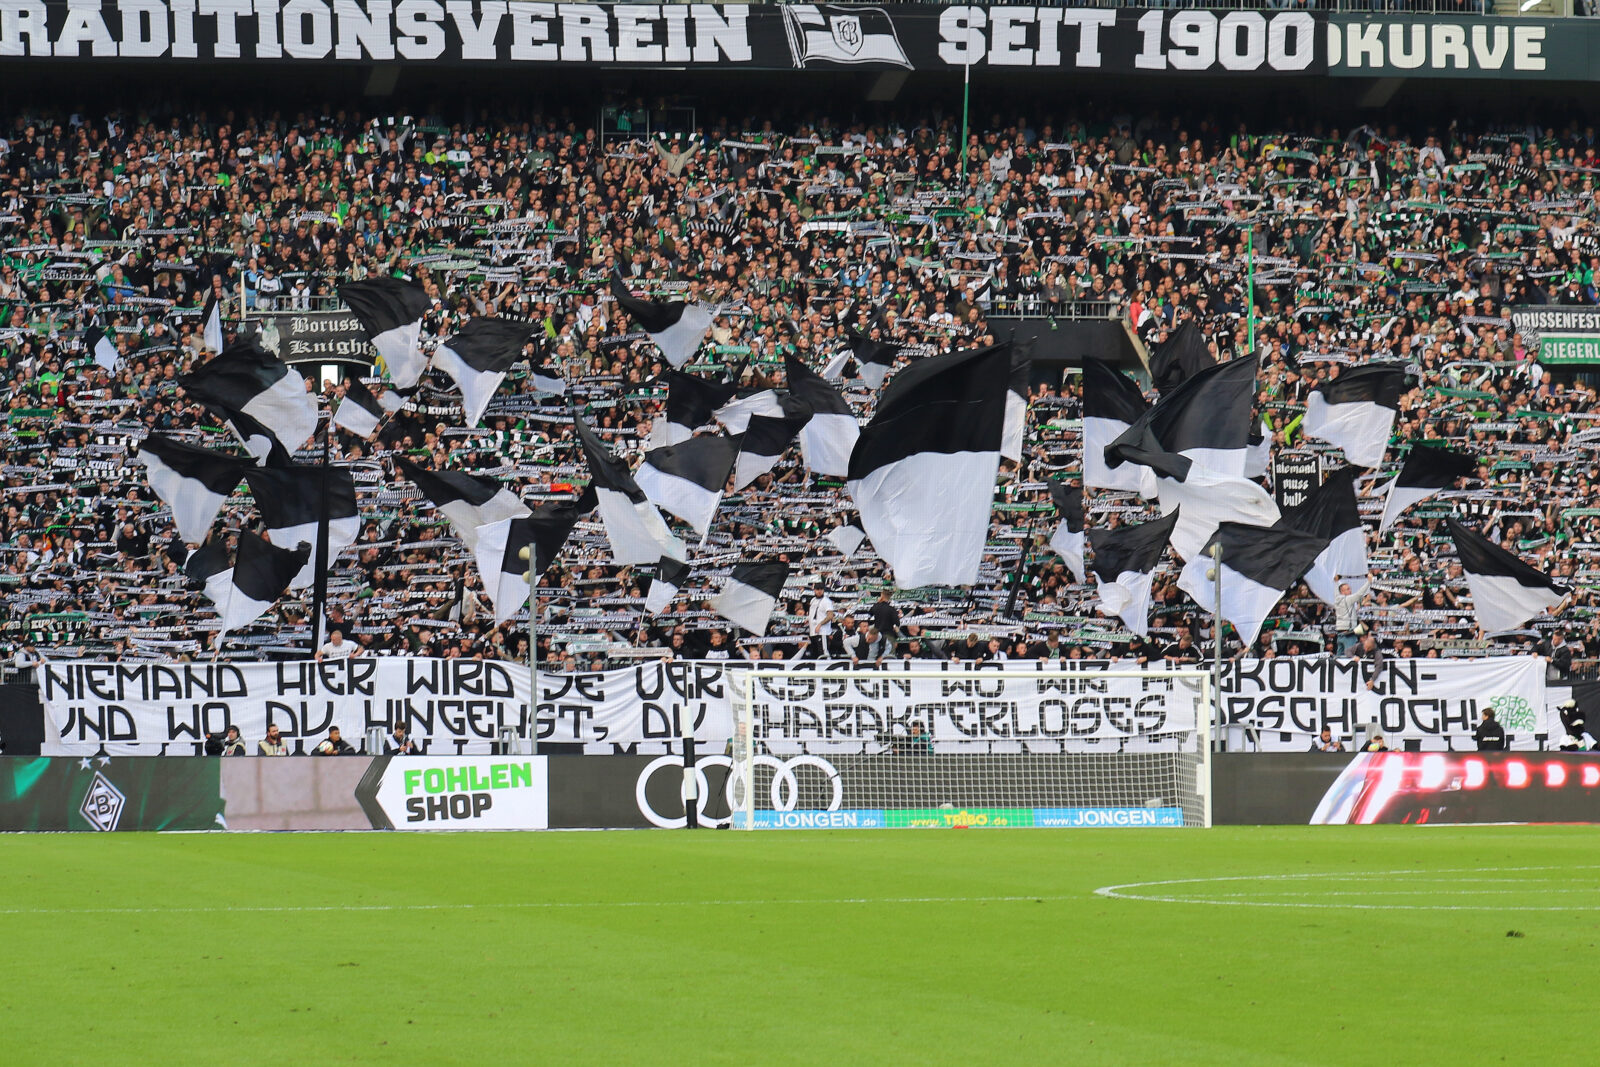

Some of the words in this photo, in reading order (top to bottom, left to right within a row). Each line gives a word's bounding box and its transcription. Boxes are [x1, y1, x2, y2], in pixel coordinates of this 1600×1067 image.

[938, 6, 1104, 68] SEIT
[1134, 10, 1316, 71] 1900
[290, 317, 366, 335] Boruss
[288, 339, 378, 357] Knights
[1283, 491, 1307, 507] bull
[45, 664, 248, 701] NIEMAND
[277, 659, 376, 696] HIER
[406, 659, 514, 699] WIRD
[543, 673, 605, 702] JE
[941, 660, 1004, 698] WO
[1036, 661, 1110, 695] WIR
[167, 702, 230, 740] WO
[266, 700, 334, 738] DU
[364, 698, 609, 742] HINGEHST,
[404, 763, 532, 795] FOHLEN
[406, 793, 493, 823] SHOP
[774, 812, 858, 828] JONGEN
[1073, 810, 1156, 826] JONGEN
